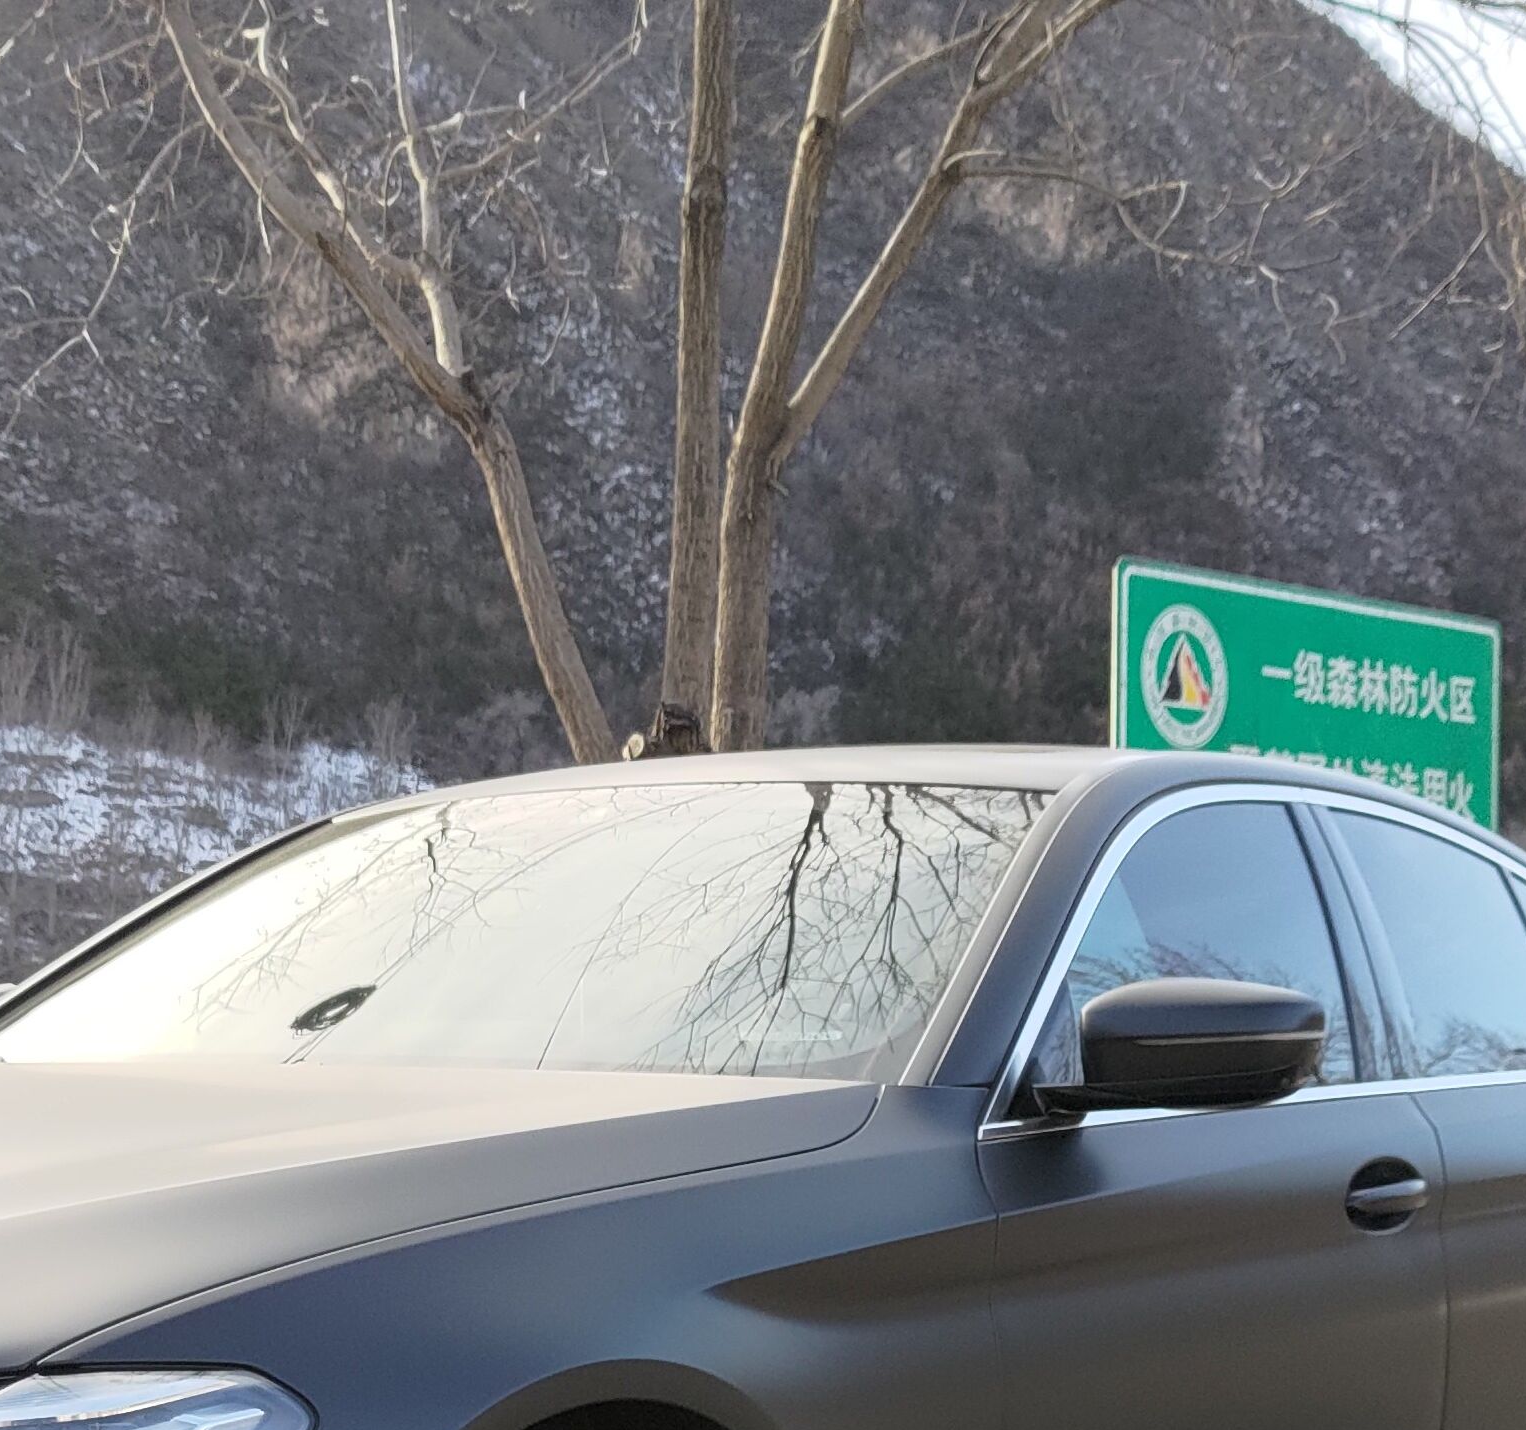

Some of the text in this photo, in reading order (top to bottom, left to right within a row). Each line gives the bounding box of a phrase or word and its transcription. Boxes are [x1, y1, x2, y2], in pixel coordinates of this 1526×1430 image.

[1261, 648, 1476, 724] 一级森林防火区
